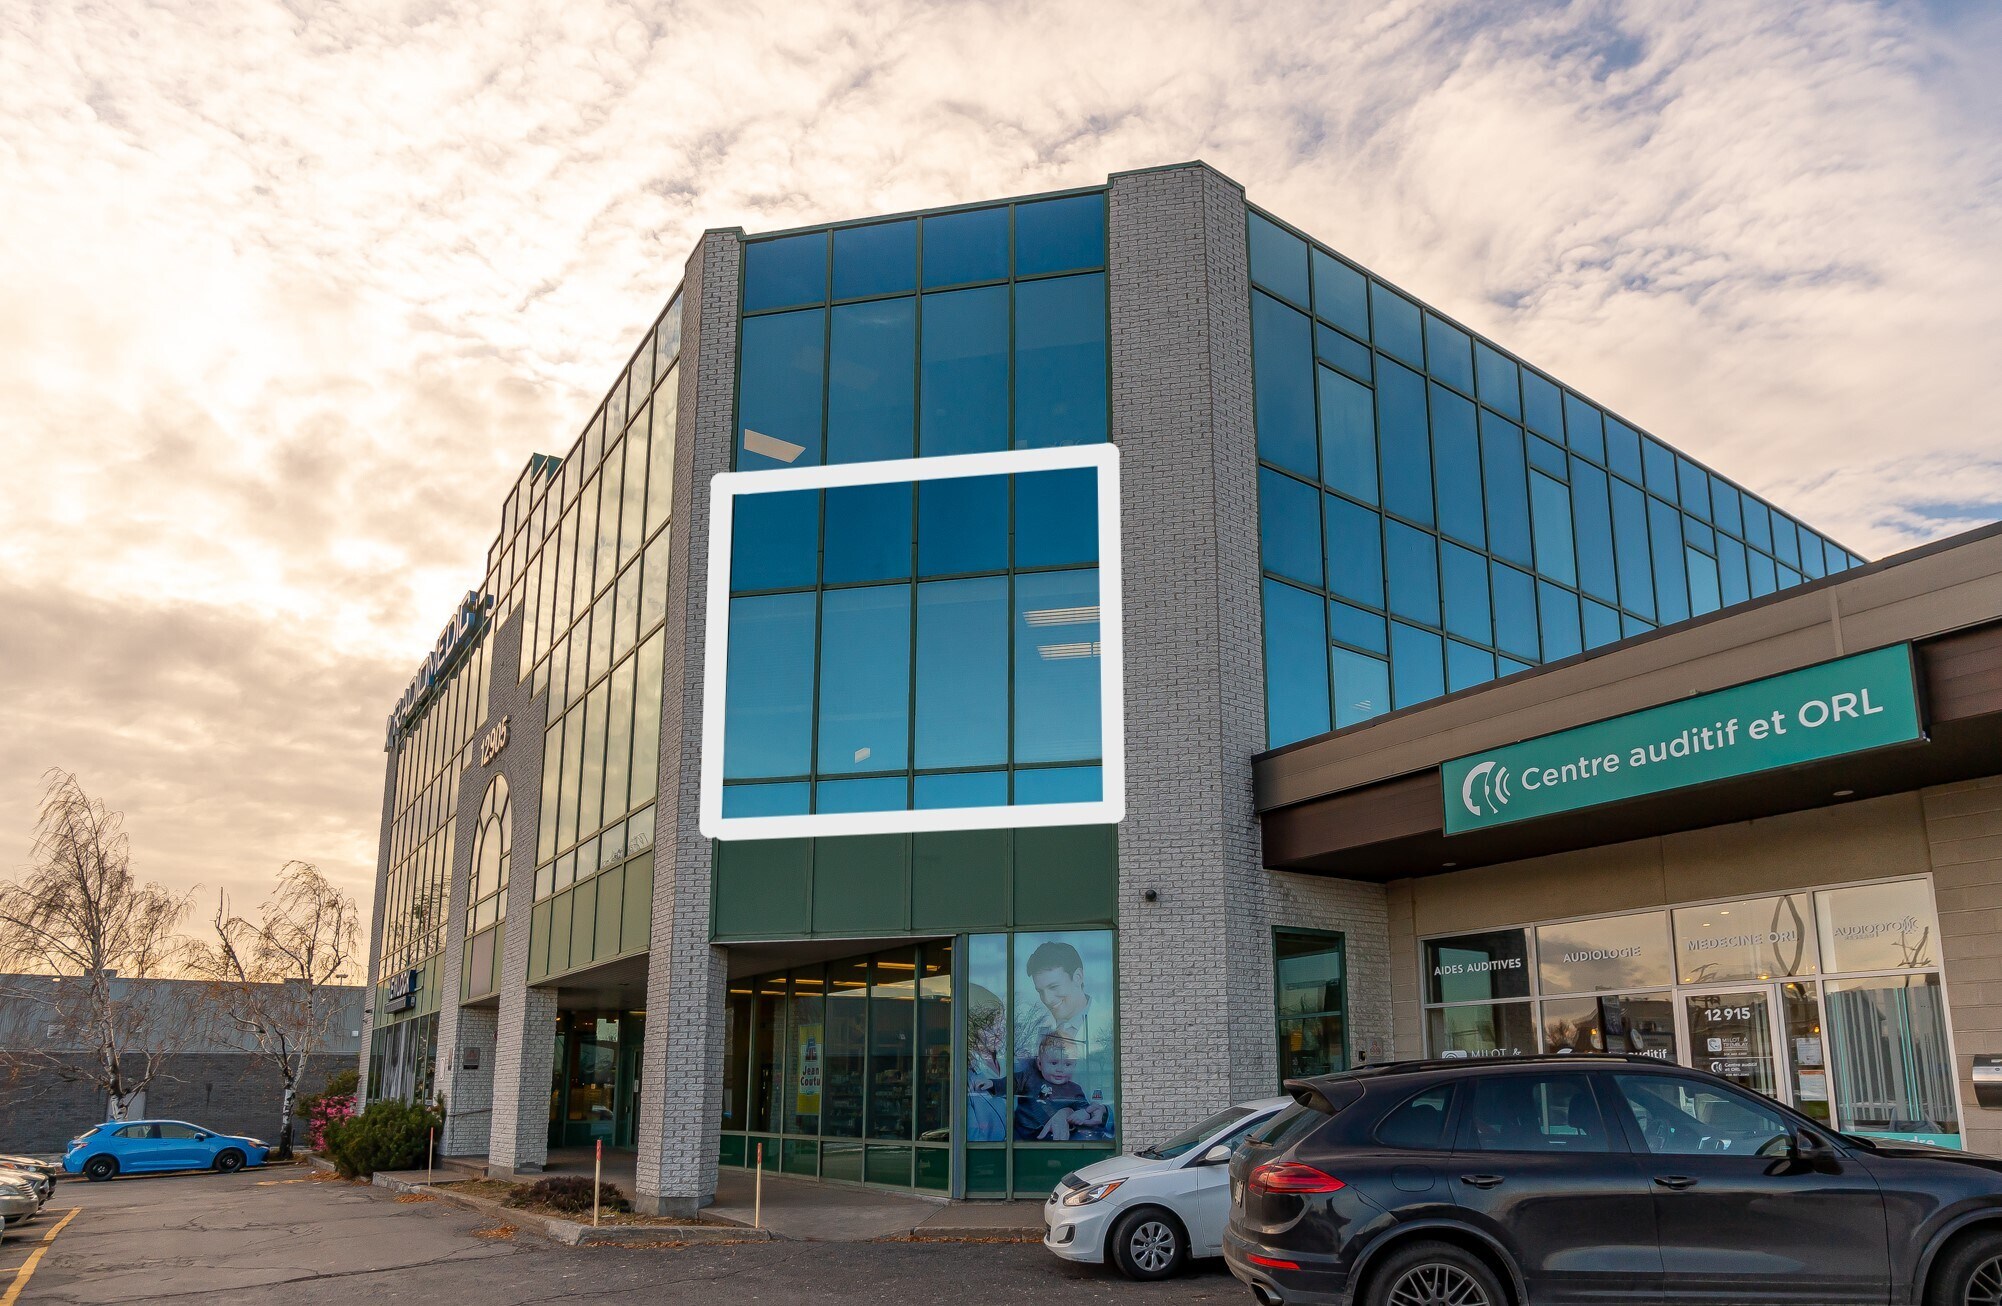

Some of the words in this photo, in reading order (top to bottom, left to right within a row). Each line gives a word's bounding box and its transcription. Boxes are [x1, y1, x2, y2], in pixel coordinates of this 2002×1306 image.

[480, 714, 509, 768] 12905
[1521, 751, 1620, 791] Centre
[1629, 718, 1739, 767] auditif
[1748, 710, 1787, 740] et
[1798, 687, 1884, 729] ORL
[1686, 933, 1763, 951] MEDECINE
[1768, 931, 1800, 944] ORL
[1562, 946, 1642, 963] AUDIOLOGIE
[1434, 964, 1464, 976] AIDES
[1466, 958, 1522, 973] AUDITIVES
[802, 1065, 820, 1076] Jean
